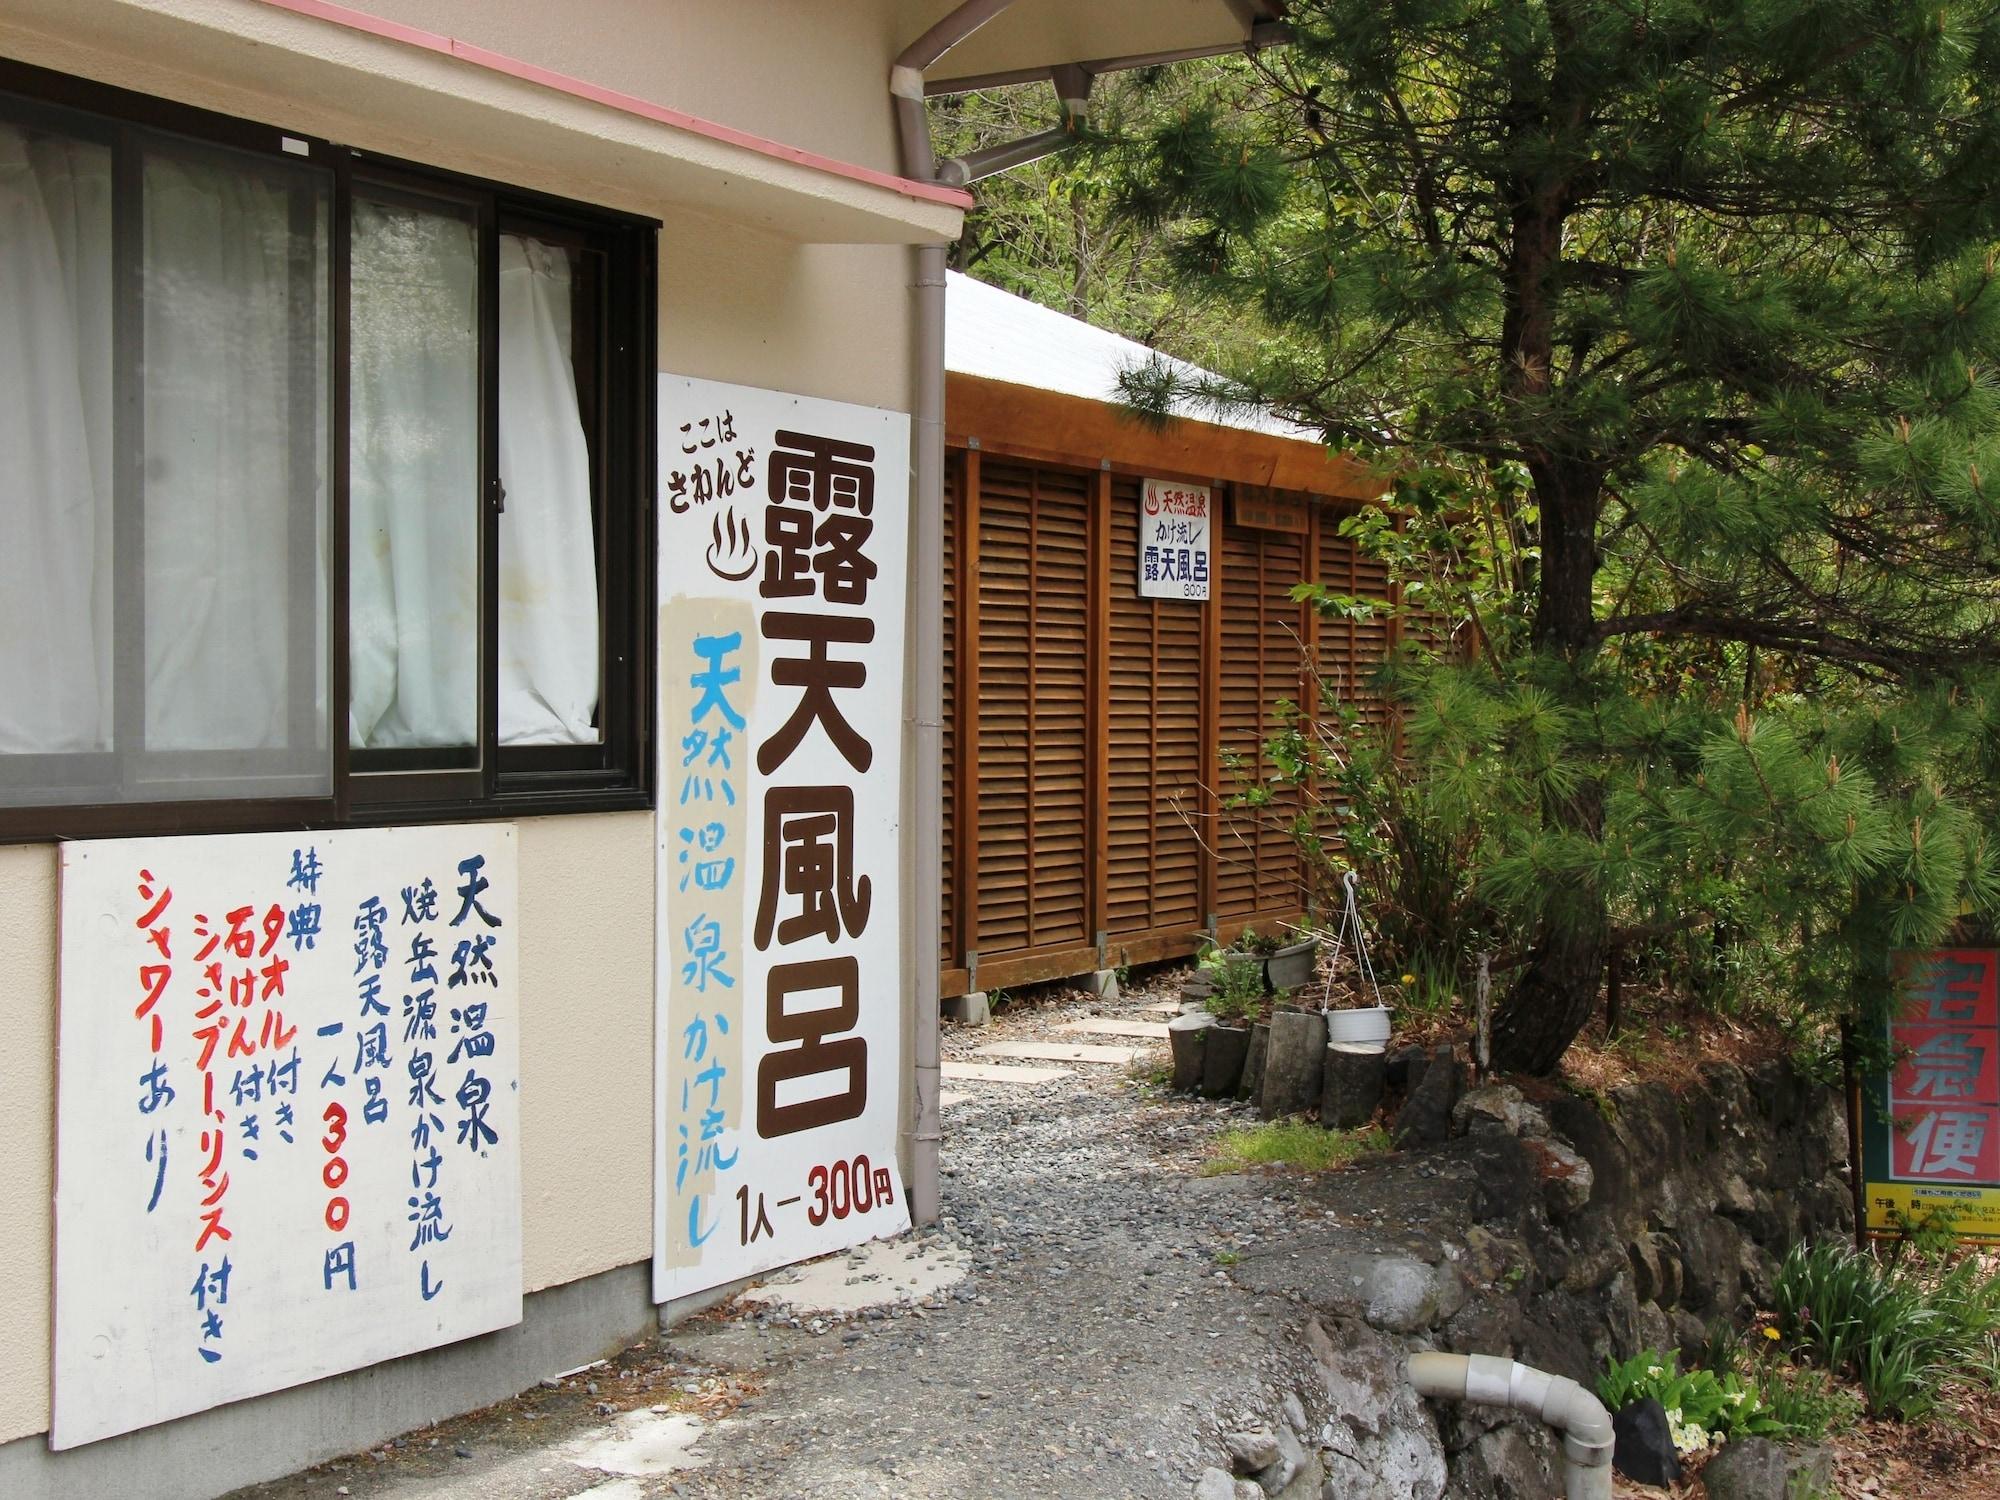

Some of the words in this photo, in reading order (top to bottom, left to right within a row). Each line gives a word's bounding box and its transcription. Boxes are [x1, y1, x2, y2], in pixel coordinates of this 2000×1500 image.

[667, 447, 755, 514] さわんど
[679, 409, 738, 454] ここは
[1155, 518, 1205, 545] かけ流し
[1163, 489, 1206, 518] 天然温泉
[1144, 545, 1208, 582] 露天風呂
[754, 429, 878, 1140] 露天風呂
[135, 869, 176, 1214] シャワーあり
[225, 905, 265, 1161] 石けん付き
[258, 904, 301, 1145] タオル付き
[353, 896, 393, 1126] 露天風呂
[447, 855, 502, 1154] 天然温泉
[676, 631, 747, 1249] 天然温泉かけ流し
[400, 877, 453, 1302] 焼岳源泉かけ流し
[1905, 957, 1990, 1176] 宅急便
